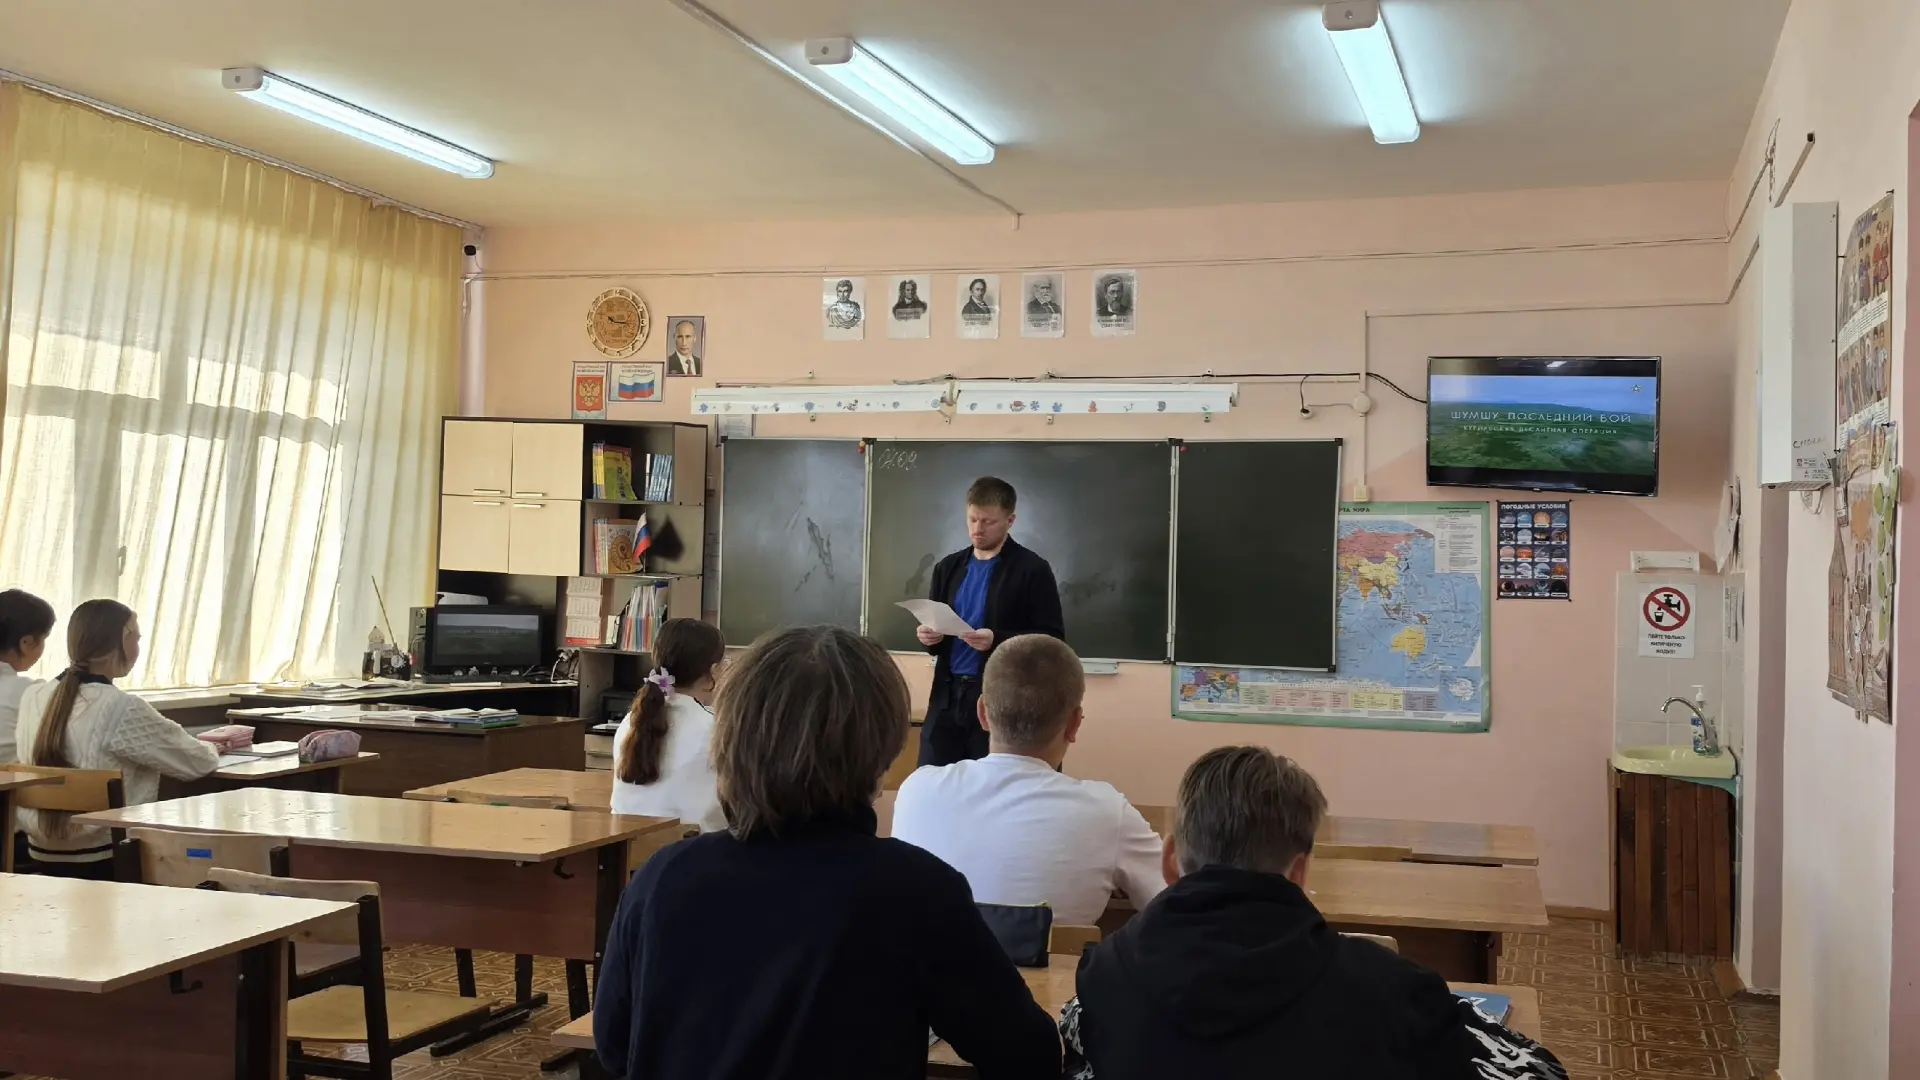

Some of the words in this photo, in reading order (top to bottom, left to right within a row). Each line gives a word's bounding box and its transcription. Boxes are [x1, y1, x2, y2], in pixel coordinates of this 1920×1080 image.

[1451, 411, 1499, 420] ШУМШУ
[1507, 412, 1592, 422] ПОСЛЕДНИЙ
[1600, 413, 1631, 423] БОЙ
